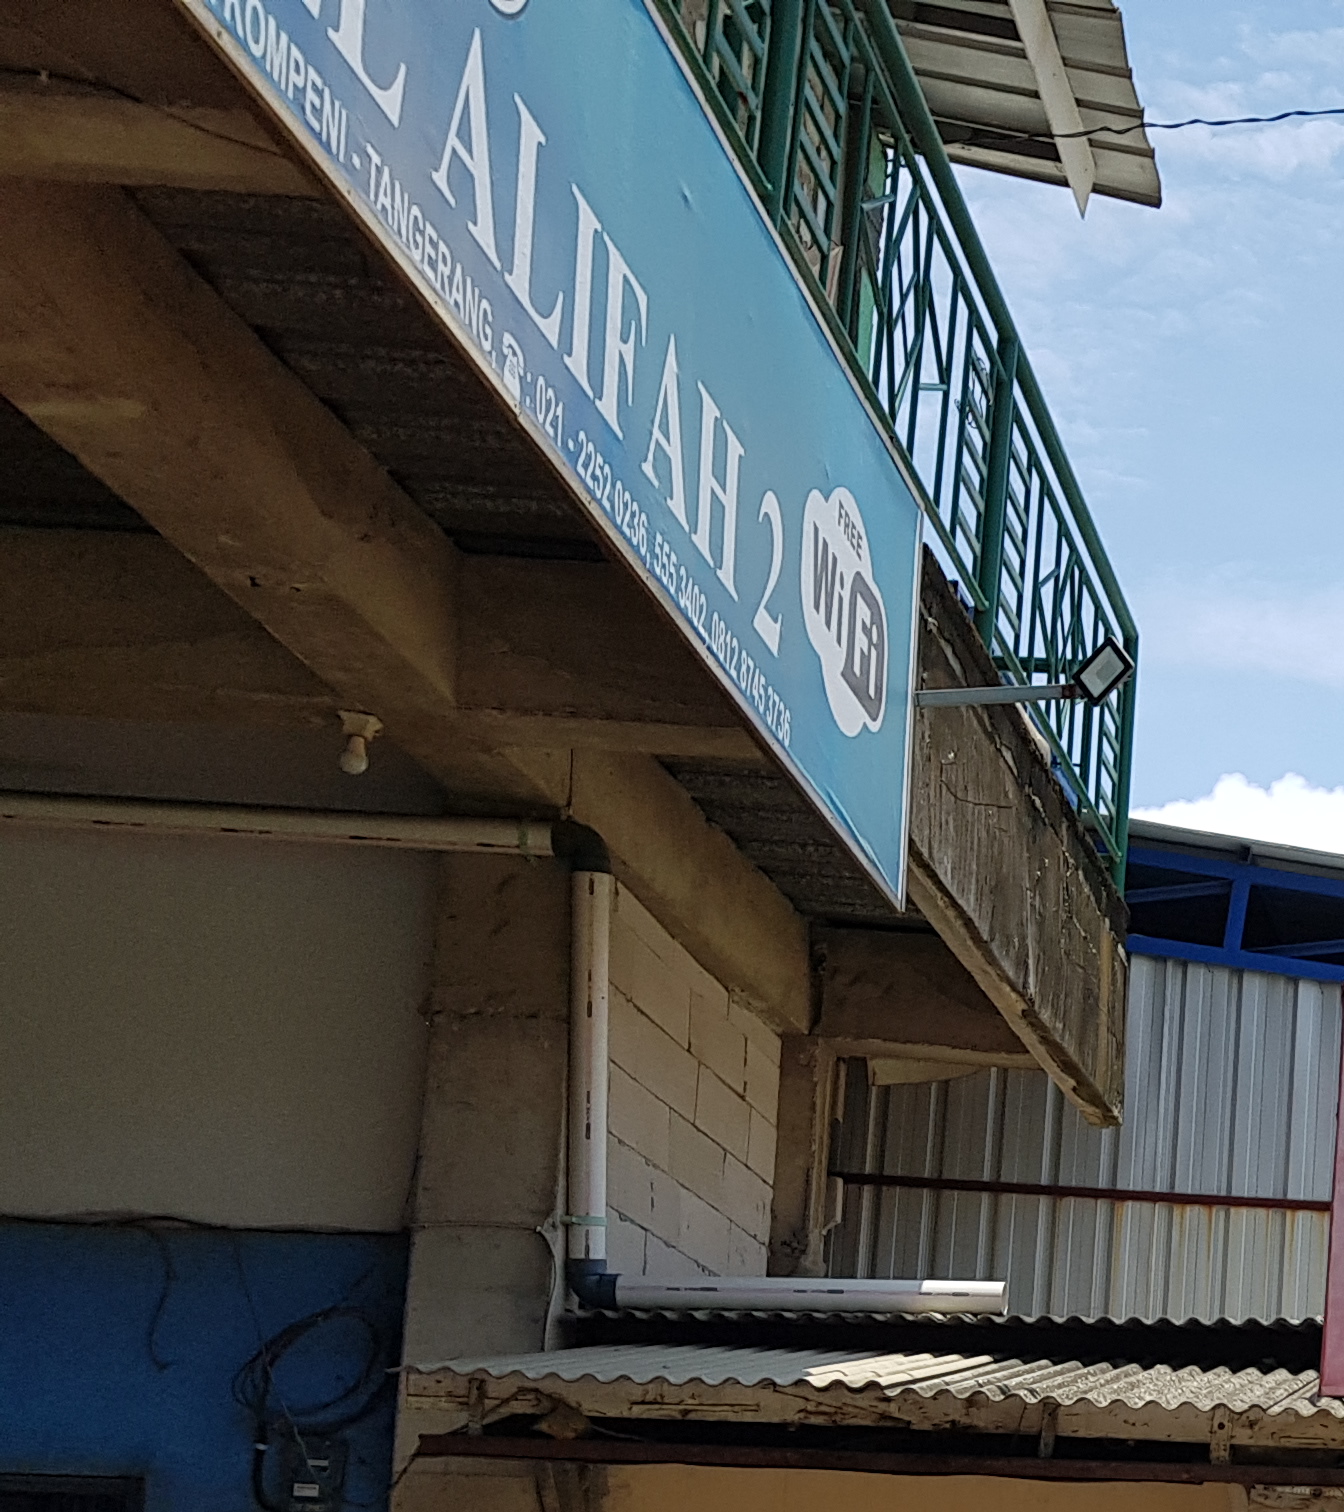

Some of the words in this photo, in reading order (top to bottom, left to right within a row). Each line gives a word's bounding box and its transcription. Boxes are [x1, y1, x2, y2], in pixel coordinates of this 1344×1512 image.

[365, 142, 498, 369] TANGERANG,
[535, 374, 564, 448] 021
[576, 429, 611, 510] 2252
[654, 534, 678, 596] 555
[711, 611, 741, 687] 0812
[740, 655, 767, 716] 8745
[766, 684, 792, 748] 3736
[430, 26, 746, 602] ALIFAH
[752, 489, 784, 657] 2
[837, 498, 864, 562] FREE
